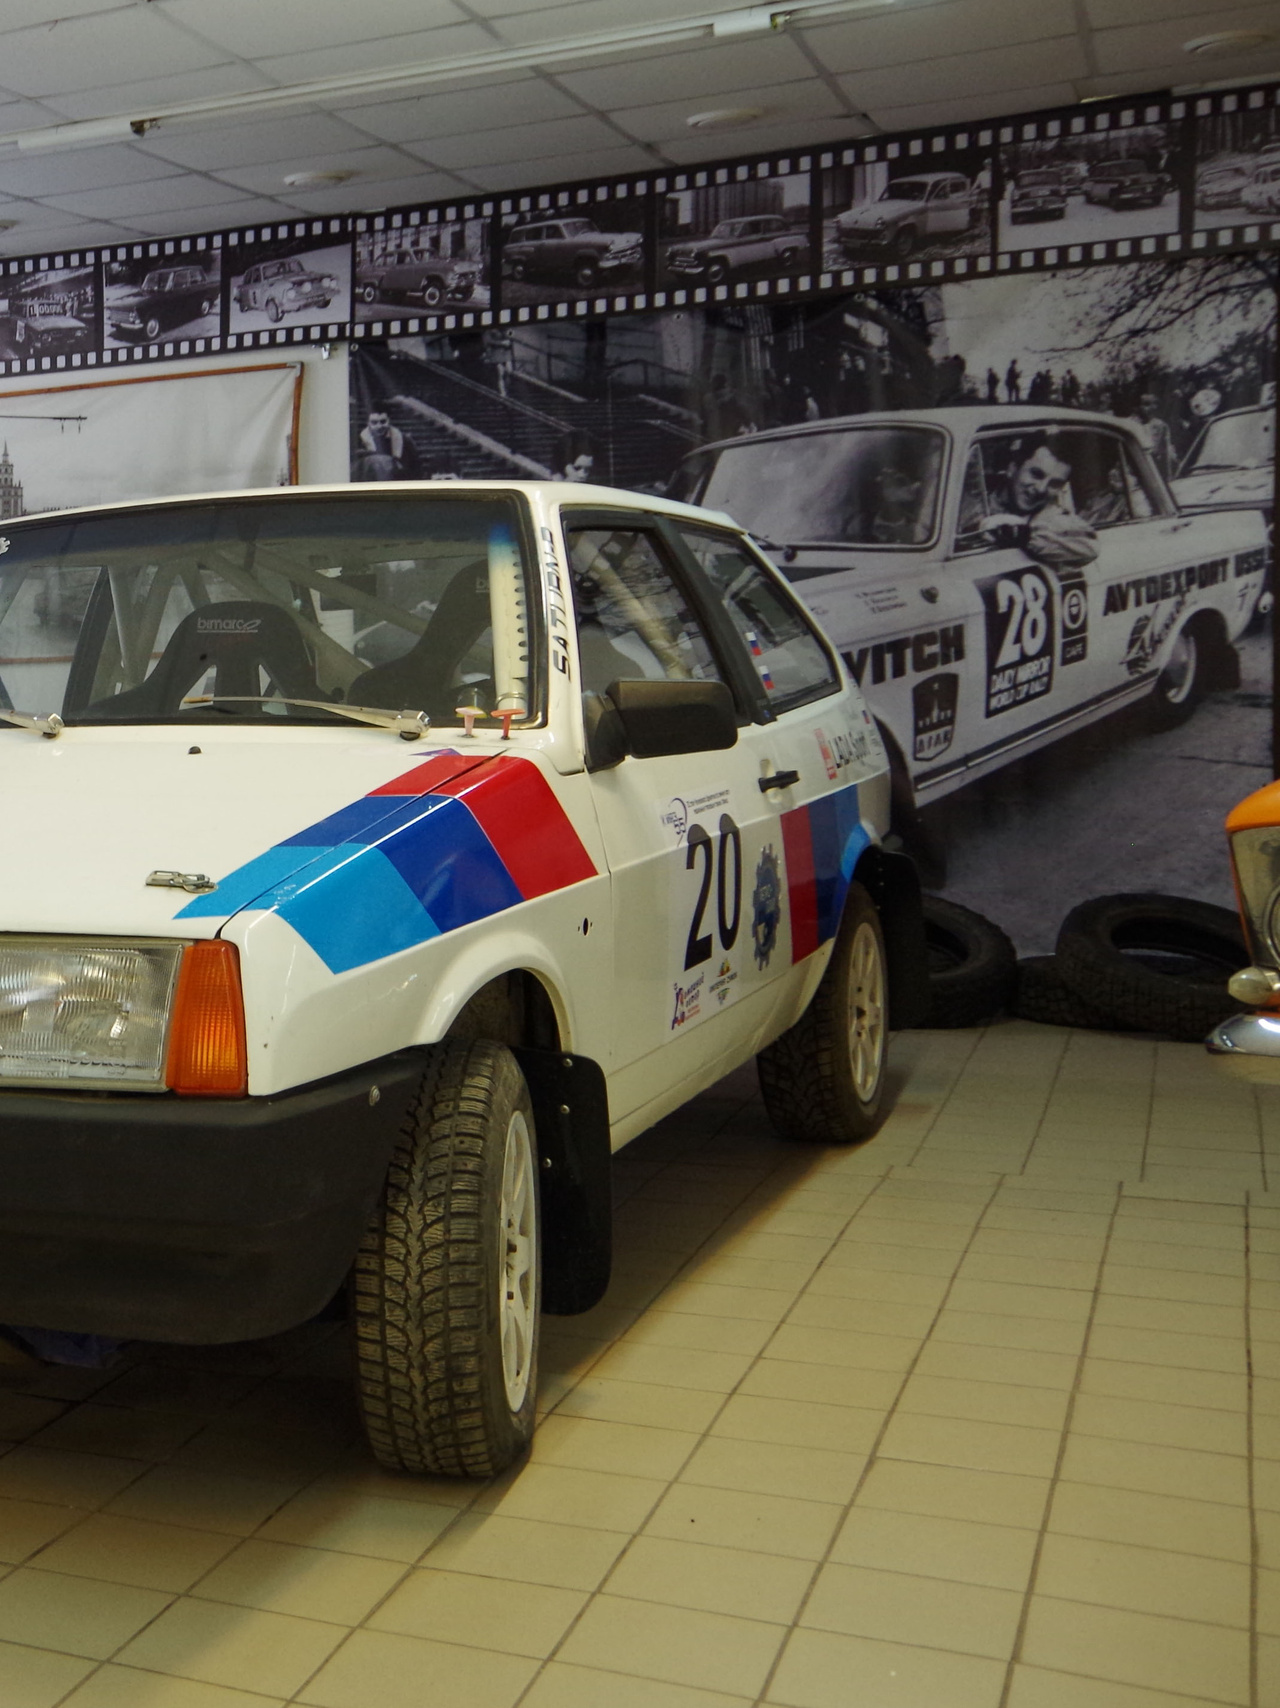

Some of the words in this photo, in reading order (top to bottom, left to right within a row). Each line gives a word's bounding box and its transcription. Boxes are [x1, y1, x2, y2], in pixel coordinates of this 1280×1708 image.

[1102, 557, 1230, 617] AVTOEXPORT
[995, 573, 1048, 669] 28
[989, 689, 1015, 711] WORLD
[990, 667, 1016, 694] DAILY
[1015, 654, 1051, 684] MIRROR
[684, 813, 742, 972] 20
